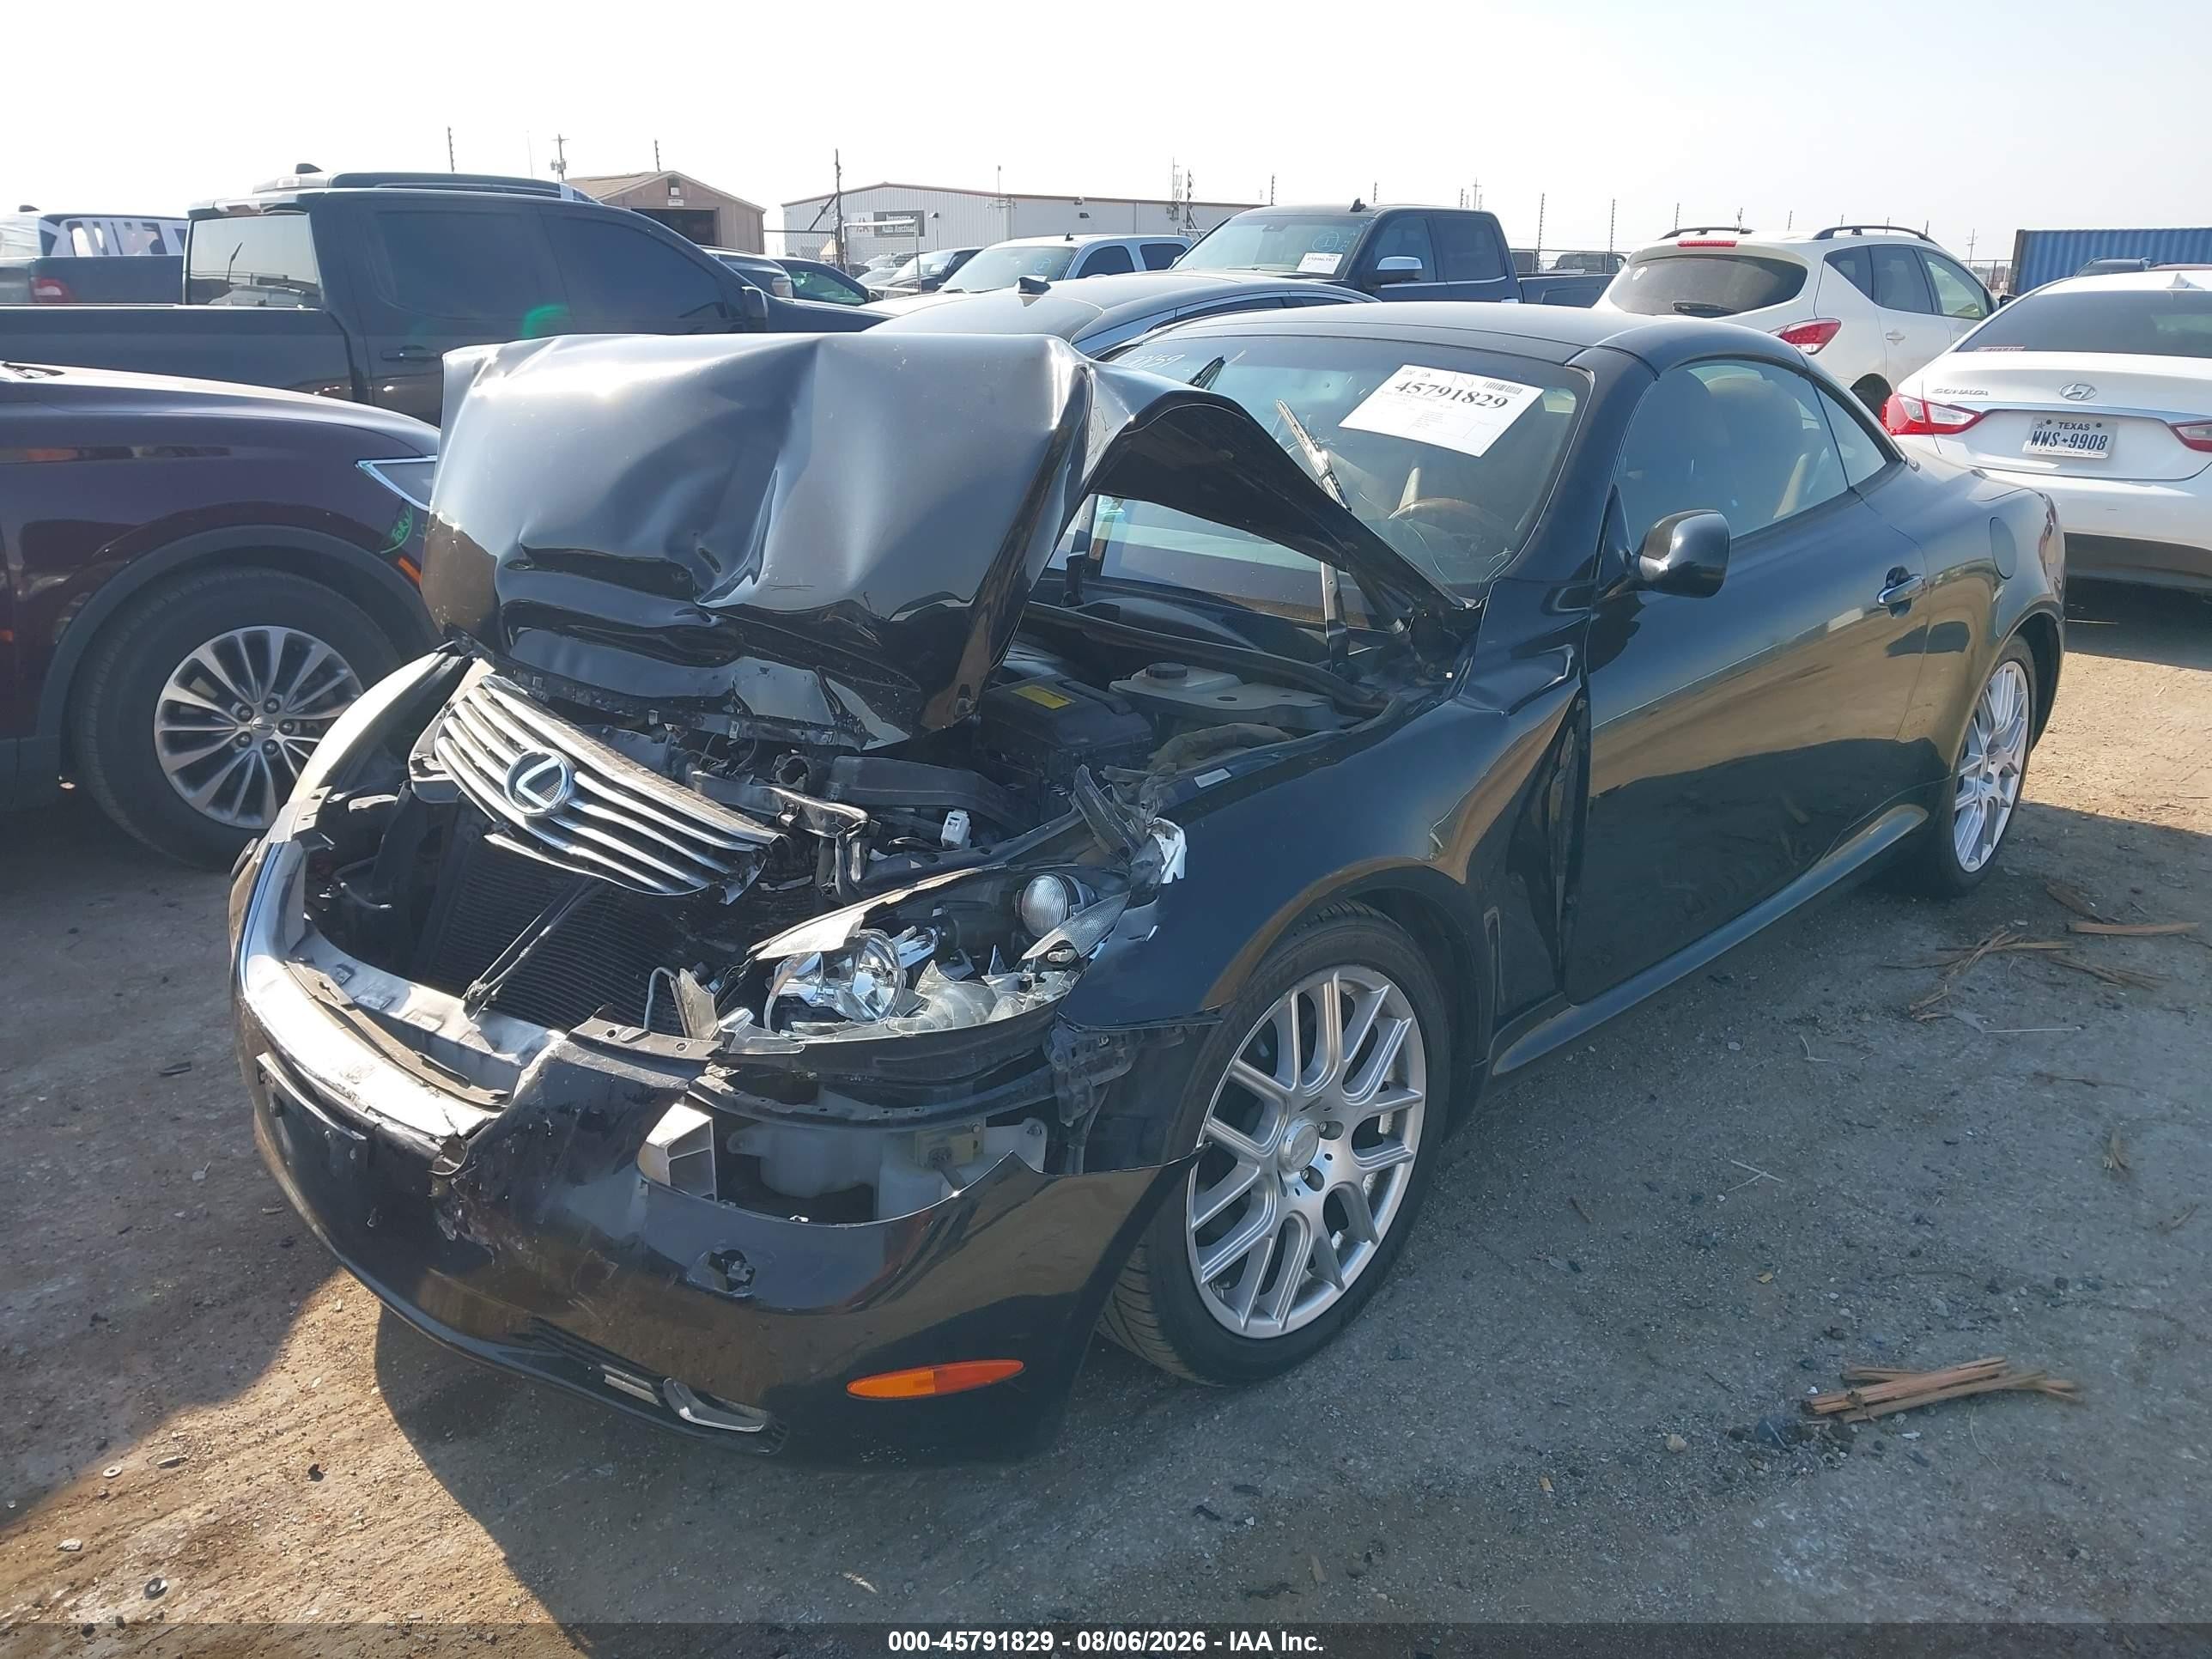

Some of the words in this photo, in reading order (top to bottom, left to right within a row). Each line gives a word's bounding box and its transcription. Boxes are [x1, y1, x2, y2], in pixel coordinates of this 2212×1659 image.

[1395, 380, 1509, 409] 45791829
[2057, 422, 2091, 431] TEXAS
[2068, 433, 2109, 451] 9908
